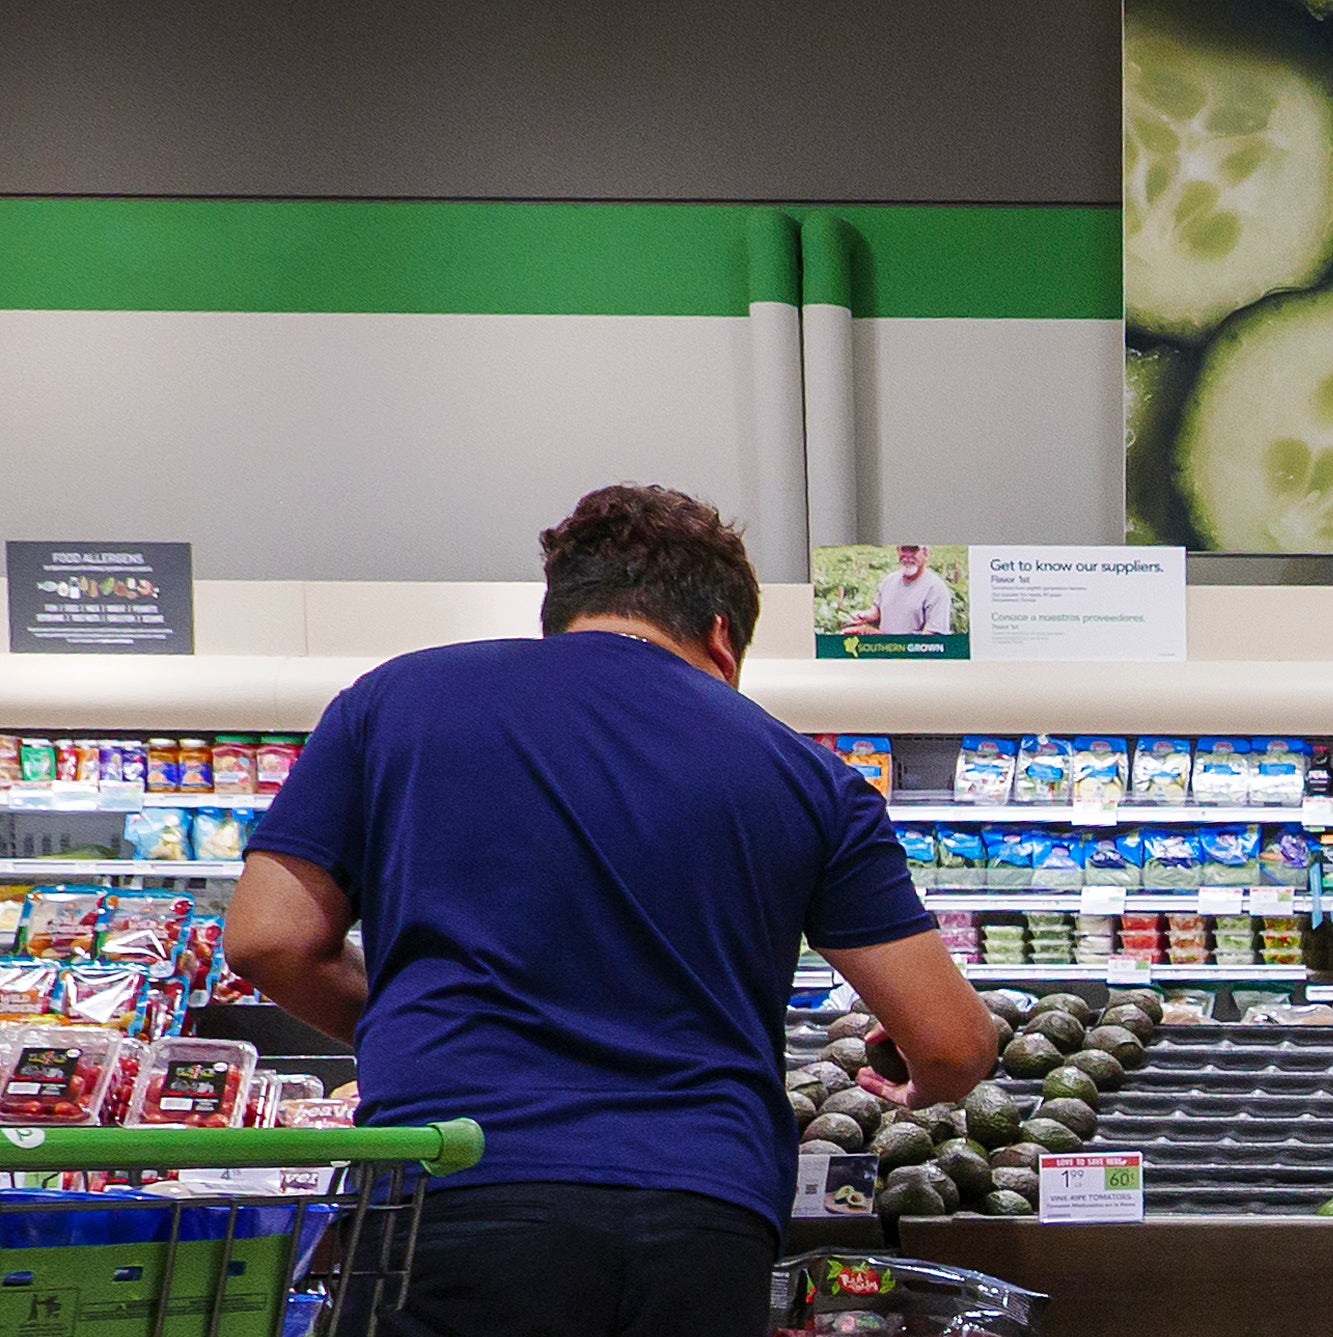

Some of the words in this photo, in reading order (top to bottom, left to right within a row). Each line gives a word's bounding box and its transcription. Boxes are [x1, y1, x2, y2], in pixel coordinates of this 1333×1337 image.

[52, 552, 82, 563] FOOD
[990, 559, 1015, 572] Get
[1019, 560, 1032, 572] to
[1036, 559, 1072, 572] know
[1076, 562, 1098, 572] our
[1101, 560, 1164, 575] suppliers.
[907, 643, 944, 652] GROWN
